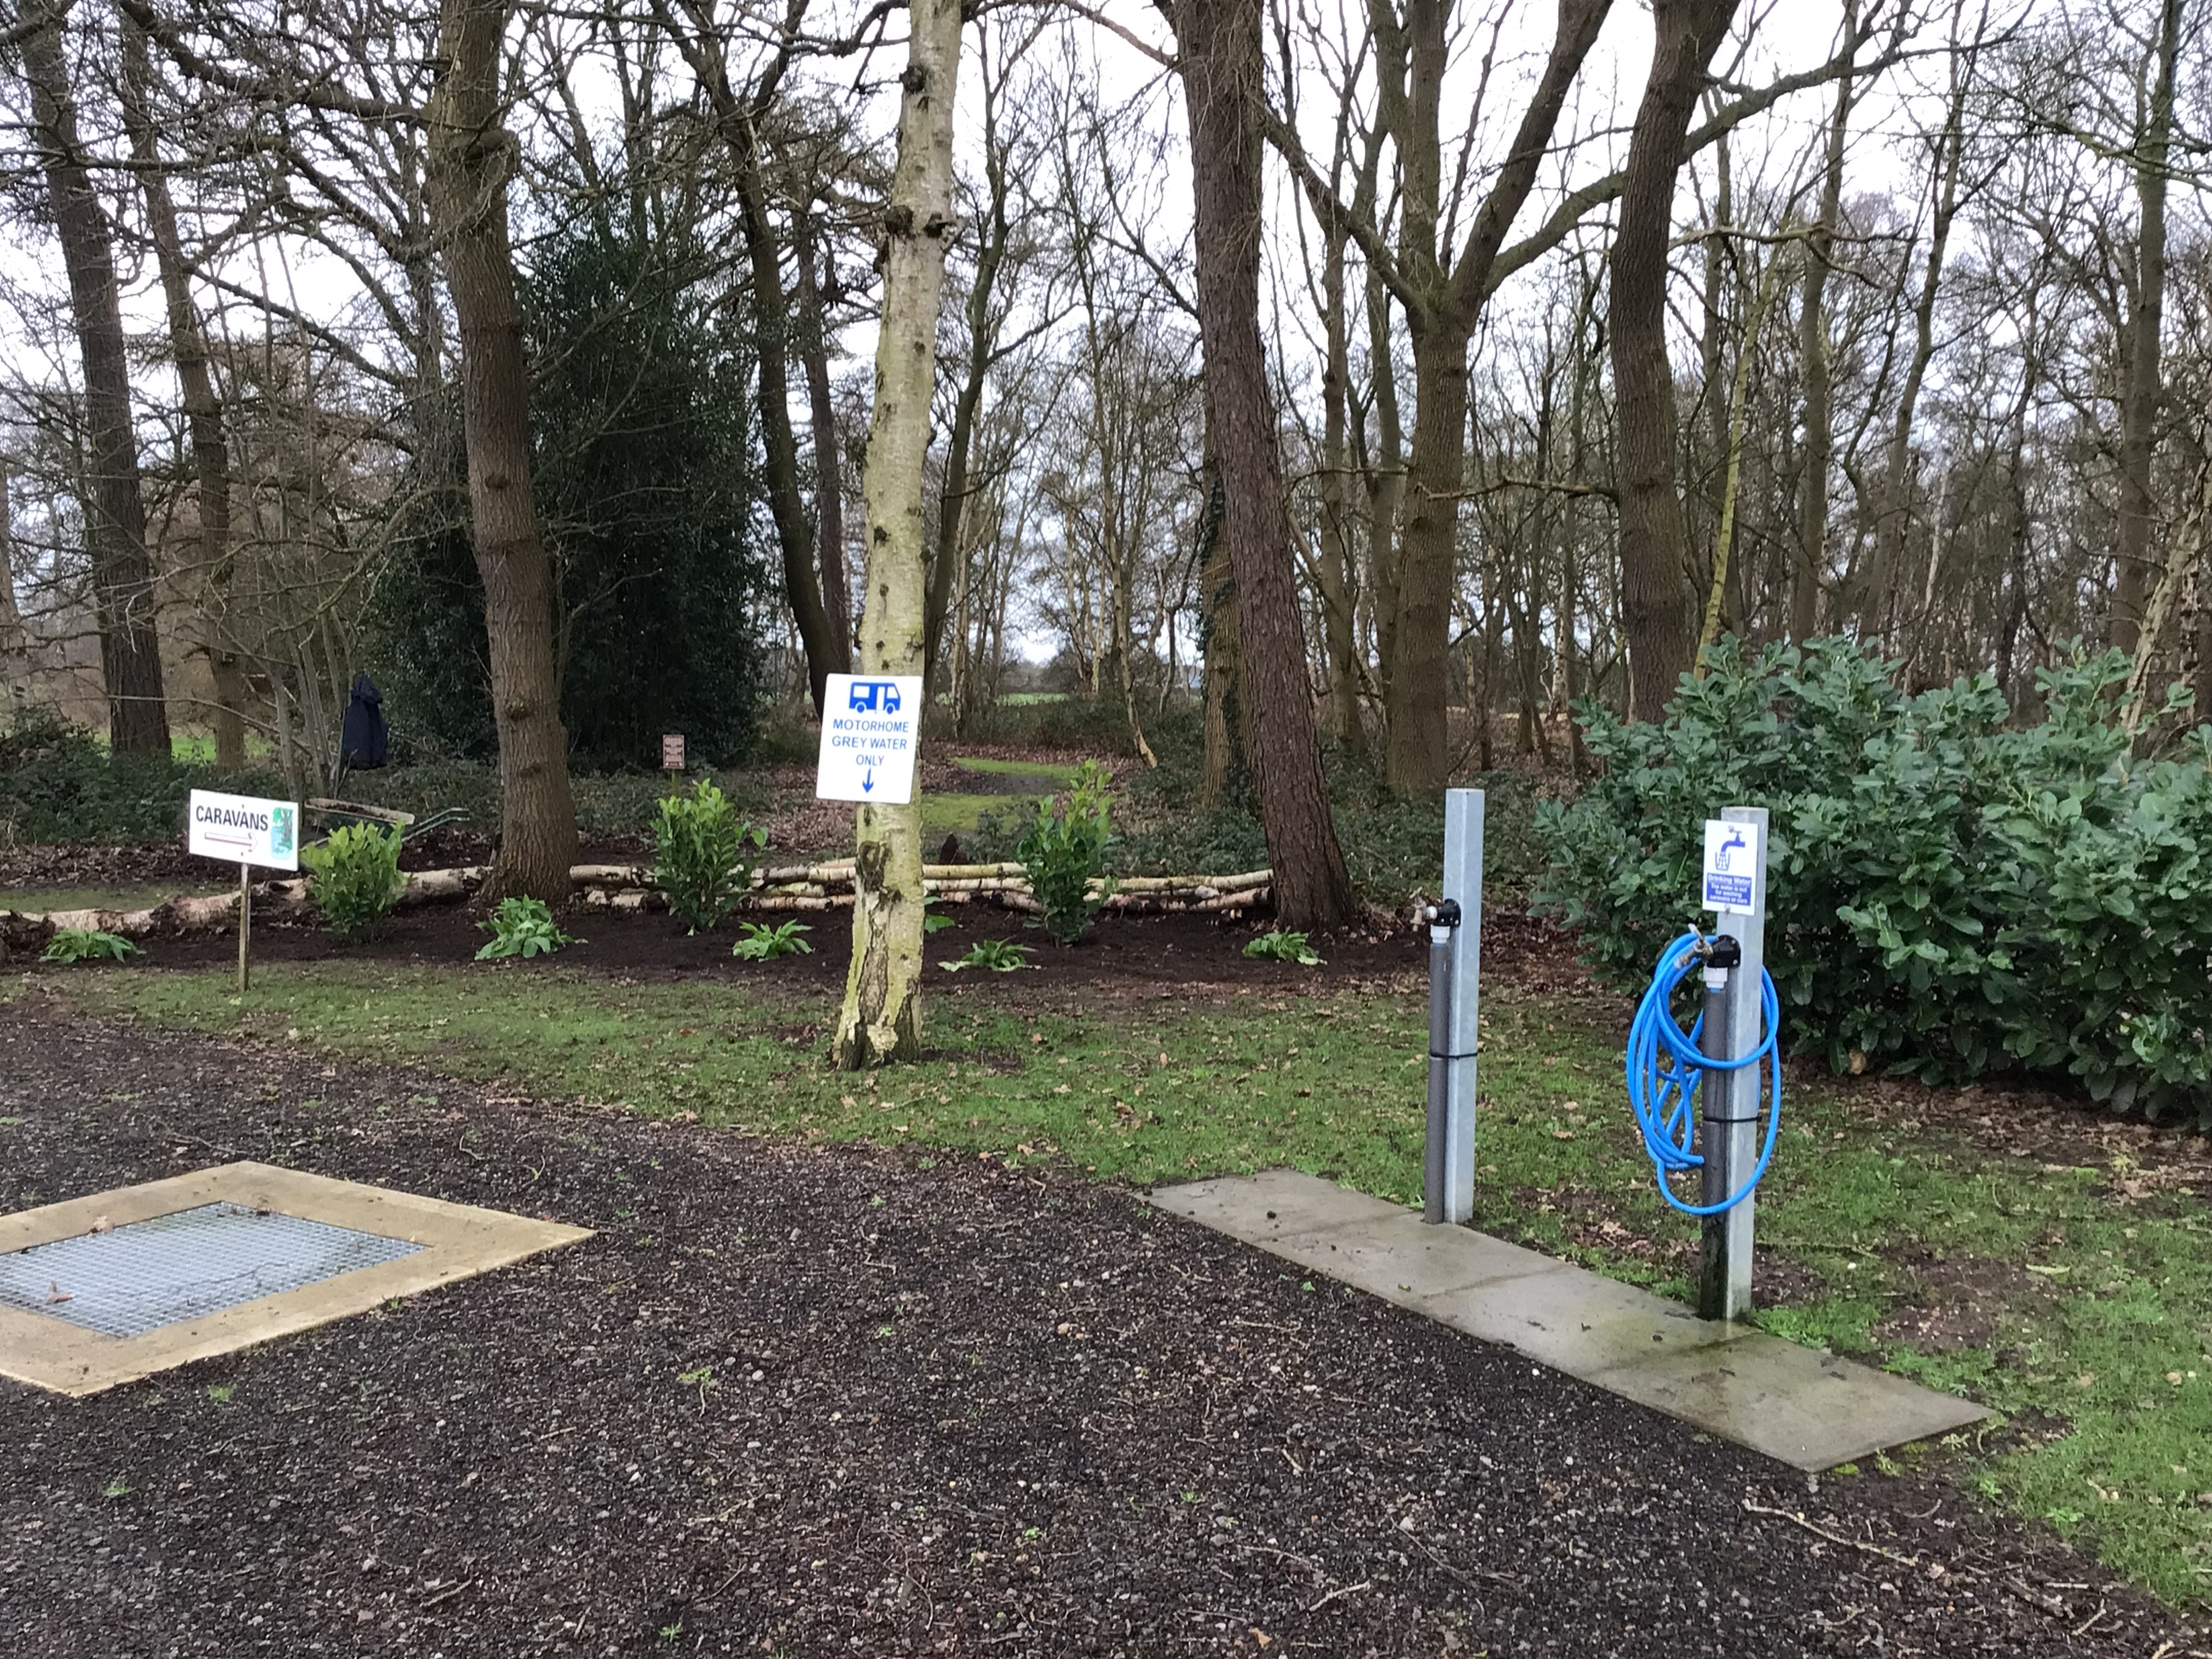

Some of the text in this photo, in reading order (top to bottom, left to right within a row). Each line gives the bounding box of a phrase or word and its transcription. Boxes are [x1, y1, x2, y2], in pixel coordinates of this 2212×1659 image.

[833, 718, 909, 733] MOTORHOME
[832, 735, 907, 750] GREY WATER
[856, 754, 884, 766] ONLY
[196, 805, 268, 832] CARAVANS
[1708, 874, 1732, 884] Drinking
